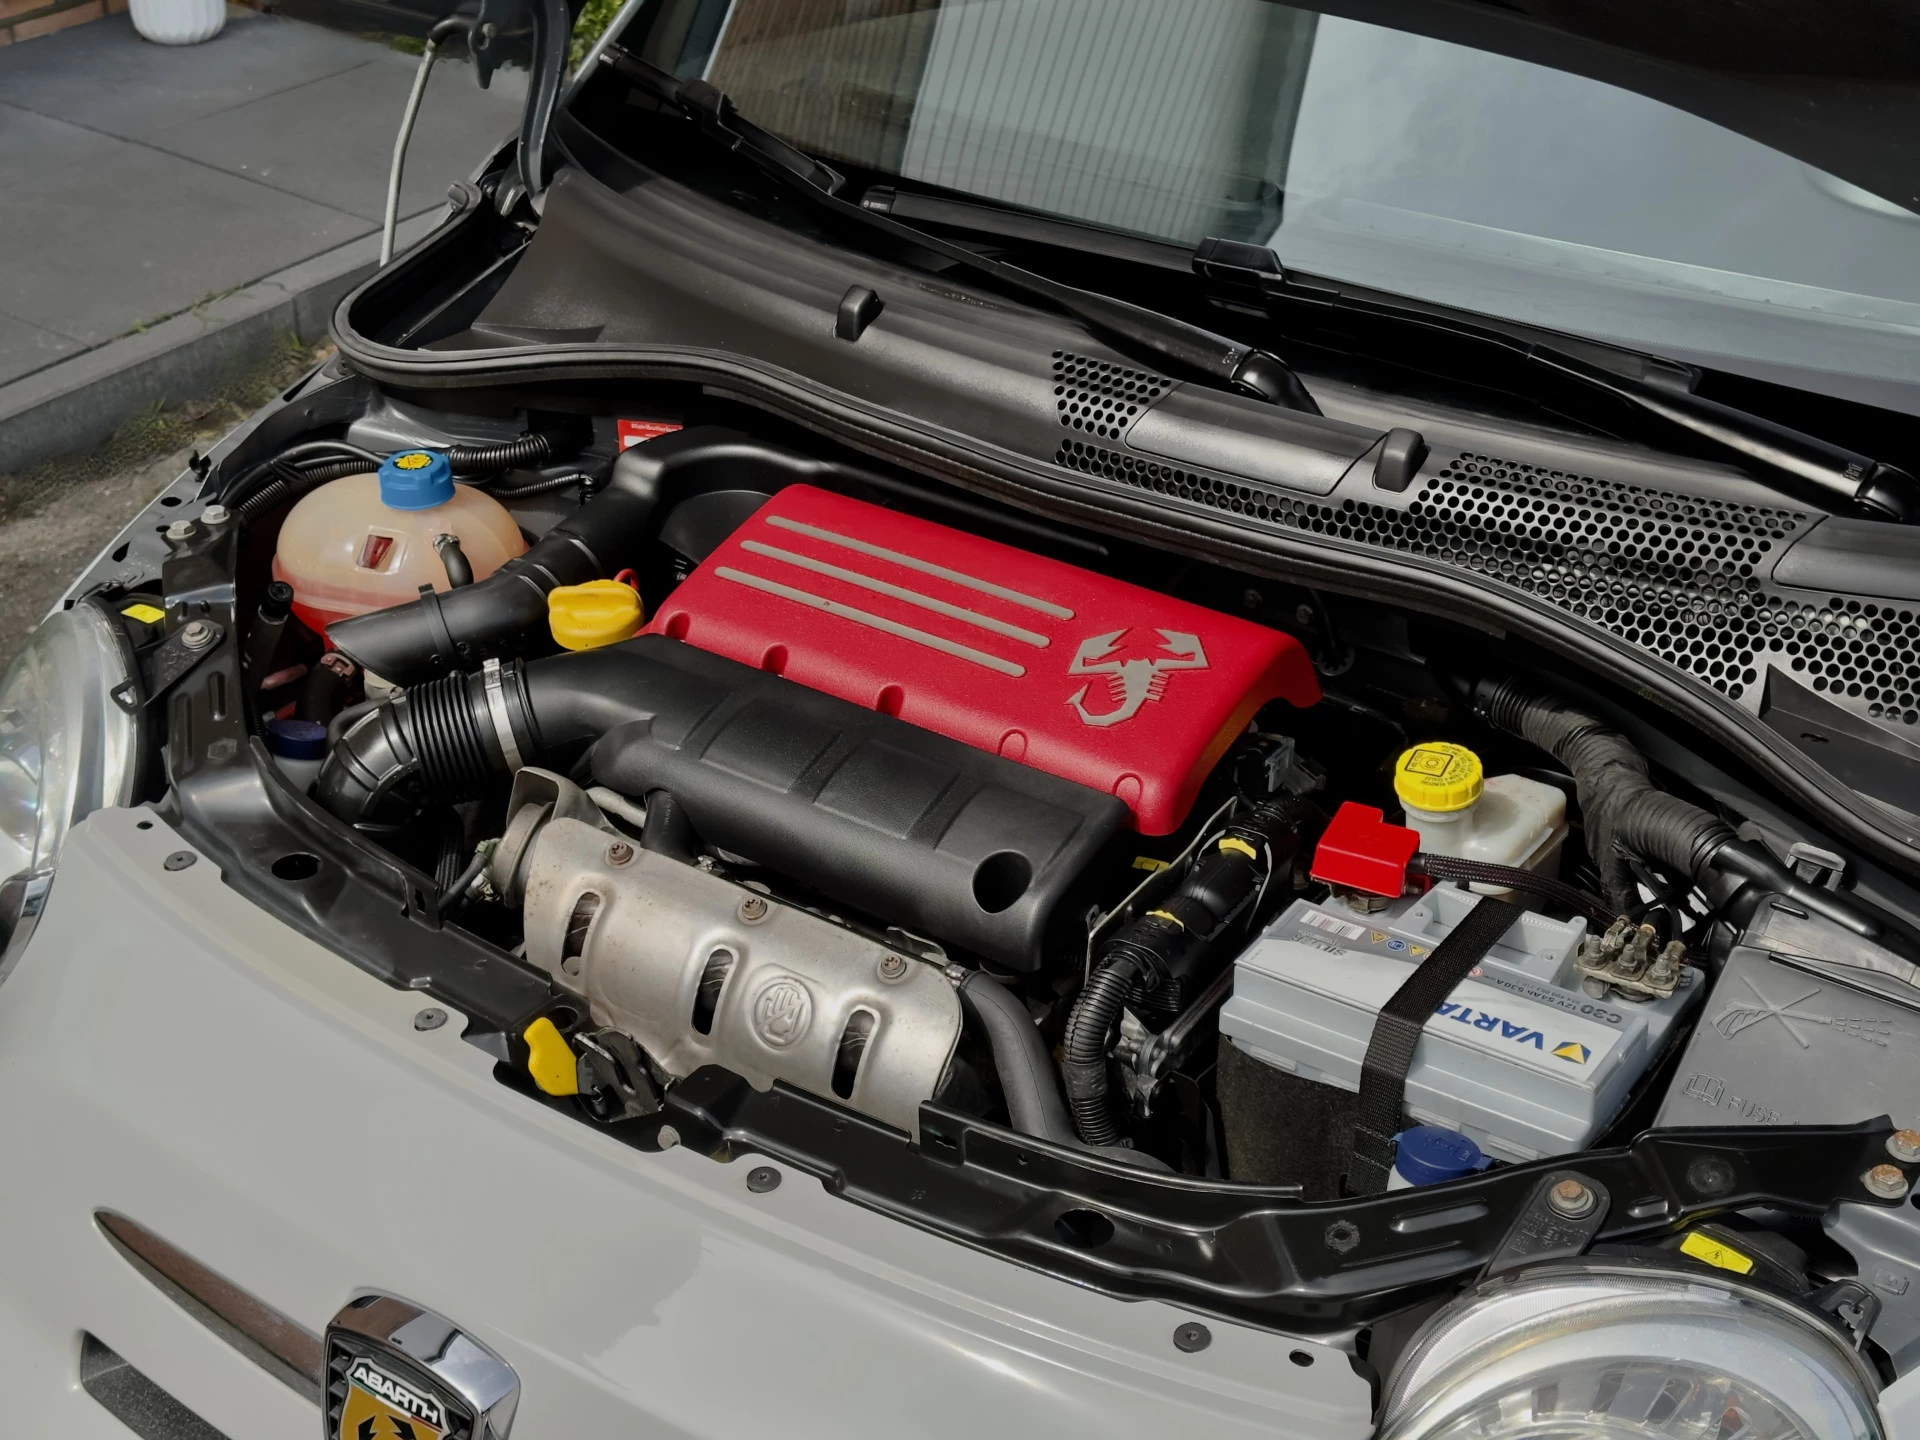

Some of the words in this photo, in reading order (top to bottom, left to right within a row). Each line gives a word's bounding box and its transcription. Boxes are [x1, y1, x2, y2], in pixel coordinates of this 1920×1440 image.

[1289, 934, 1347, 956] SILVER
[1496, 978, 1525, 993] 530A
[1527, 989, 1555, 1004] 54Ah
[1556, 1000, 1578, 1011] 12V
[1580, 1003, 1623, 1025] C30
[1434, 1002, 1544, 1051] VARTA
[1727, 1095, 1782, 1126] FUSE
[353, 1366, 439, 1424] ABARTH
